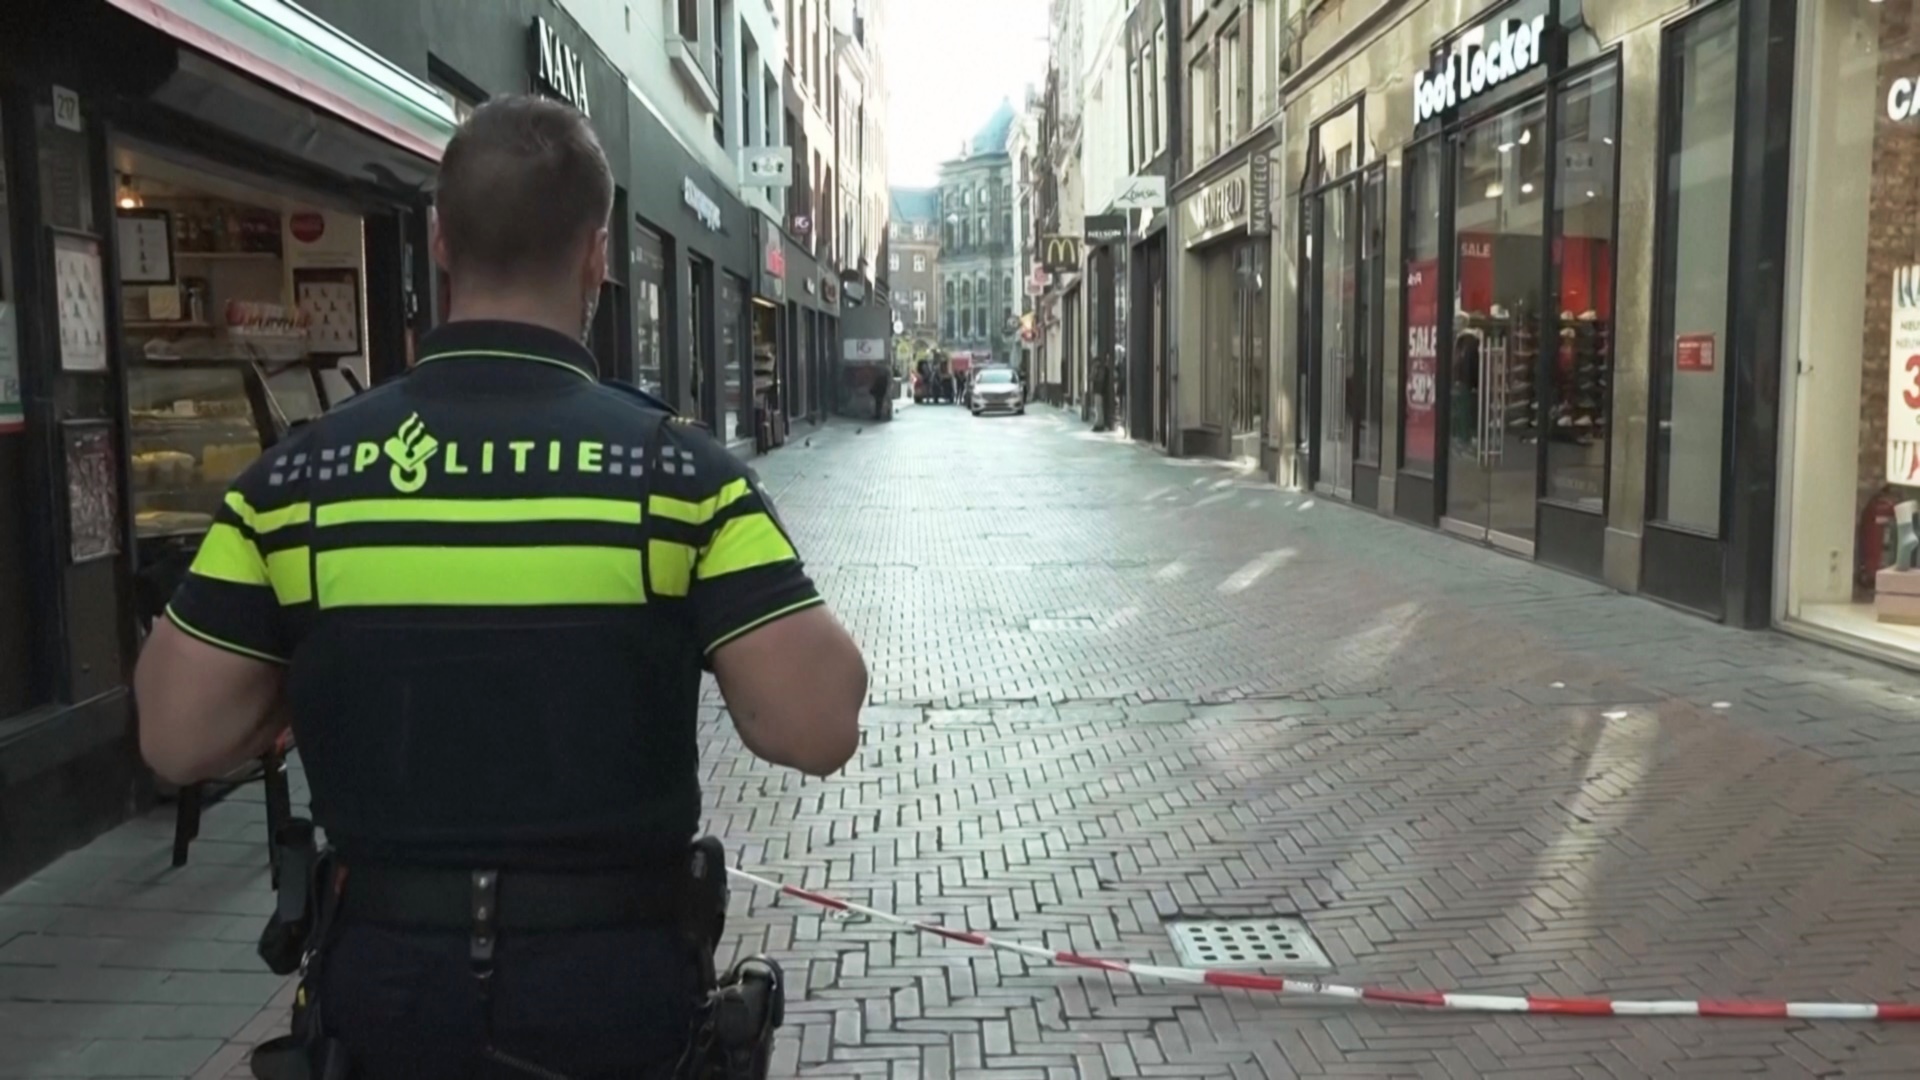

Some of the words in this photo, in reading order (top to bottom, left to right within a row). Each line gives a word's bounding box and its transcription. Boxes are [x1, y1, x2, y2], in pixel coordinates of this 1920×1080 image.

[539, 15, 591, 119] NANA
[1414, 49, 1456, 125] Foot
[1460, 14, 1544, 100] Locker
[1254, 154, 1267, 231] MANFIELD
[1088, 229, 1121, 241] NELSON
[1461, 243, 1490, 257] SALE
[1409, 326, 1437, 357] SALE
[354, 434, 603, 492] POLITIE
